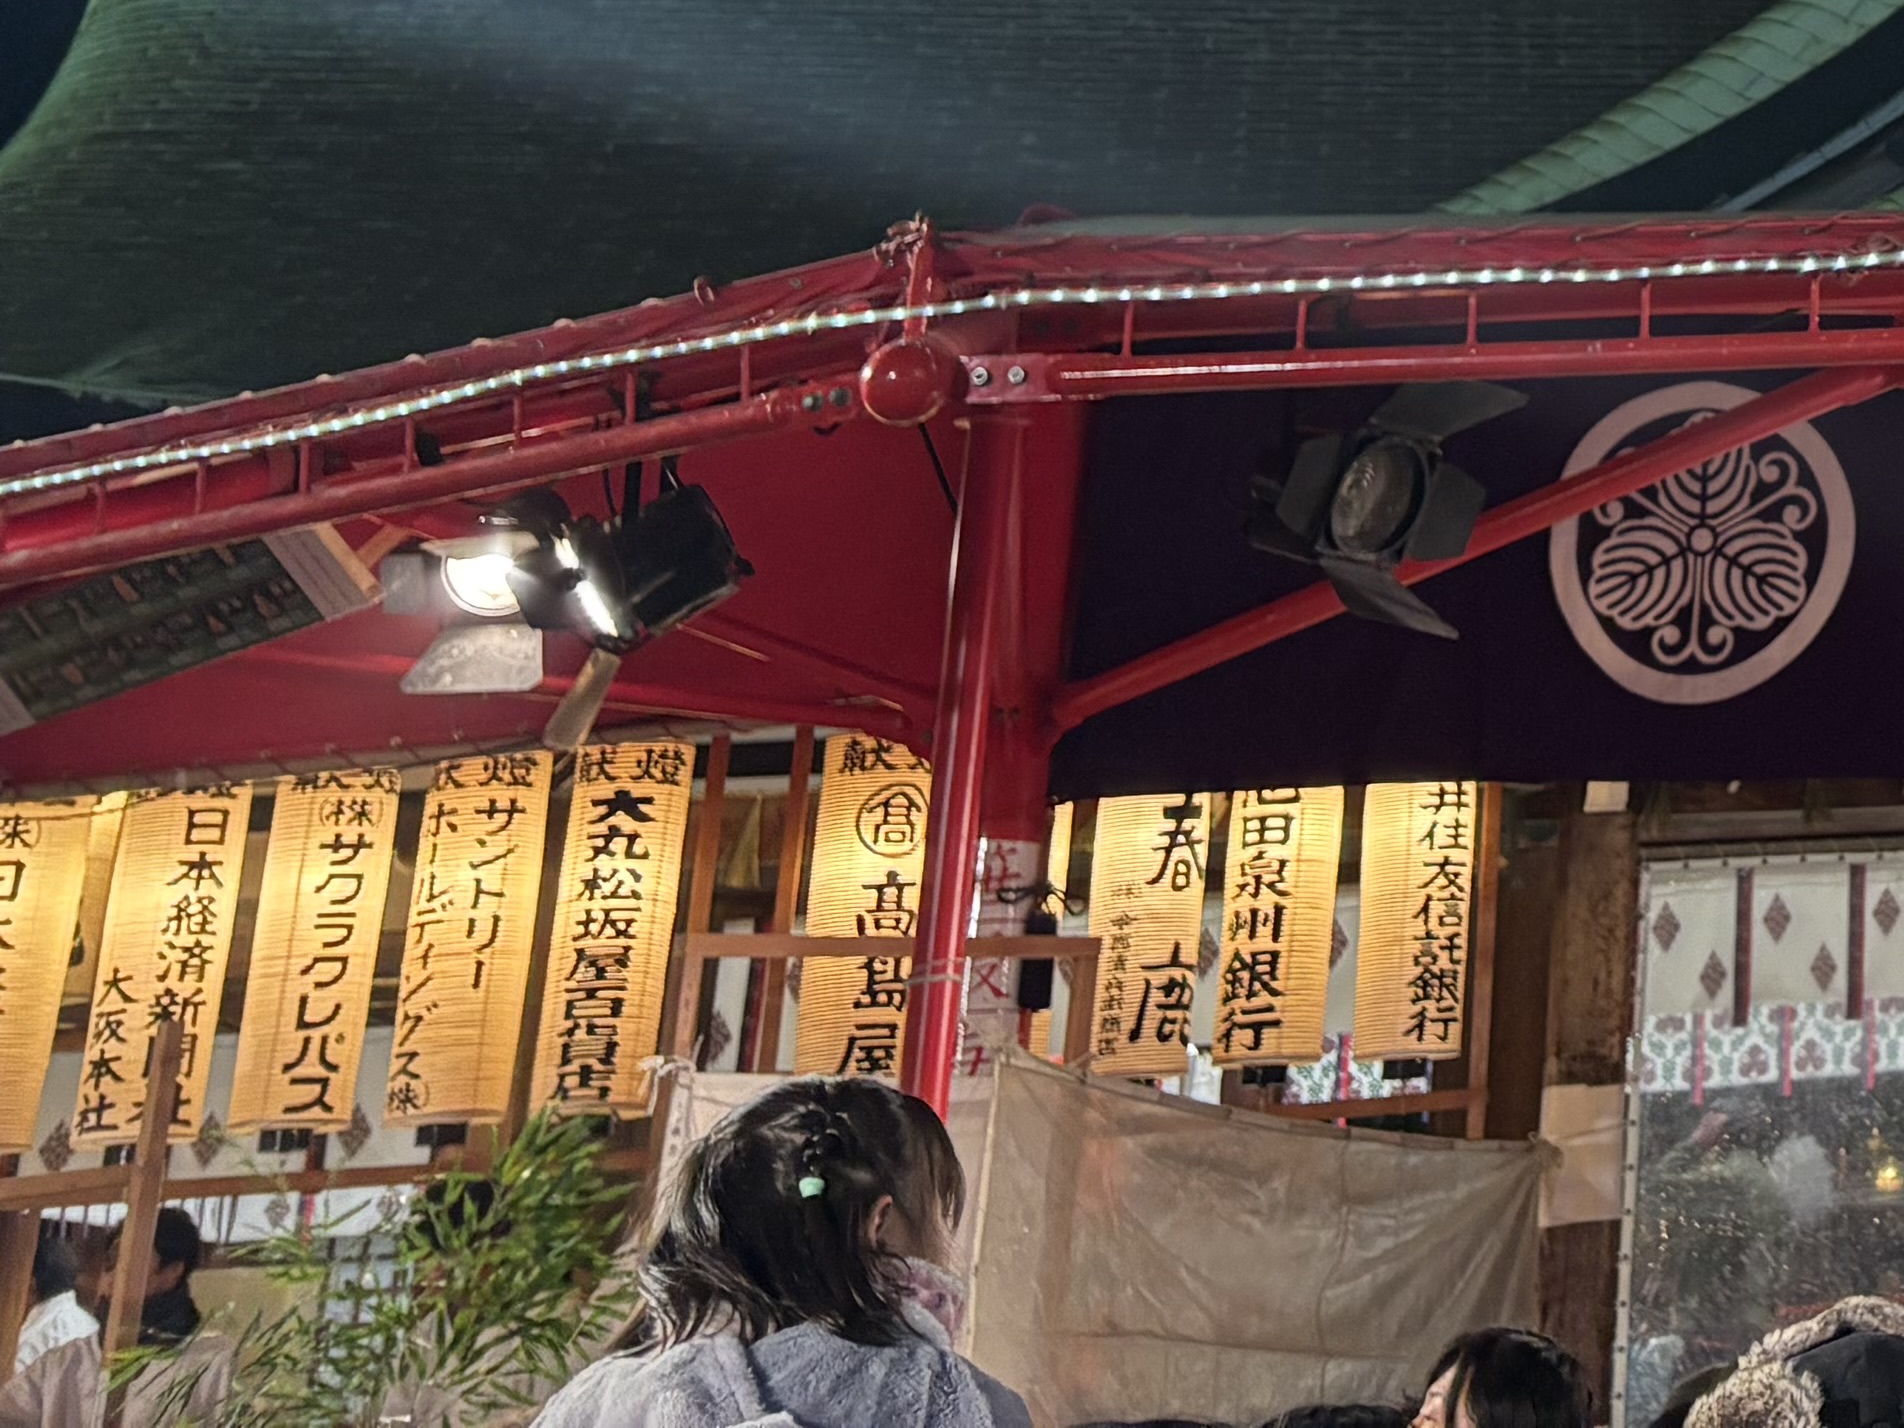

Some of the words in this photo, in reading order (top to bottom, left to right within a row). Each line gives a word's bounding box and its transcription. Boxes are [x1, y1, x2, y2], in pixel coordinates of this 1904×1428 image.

[465, 798, 526, 989] サントリー
[74, 967, 138, 1136] 大阪本社
